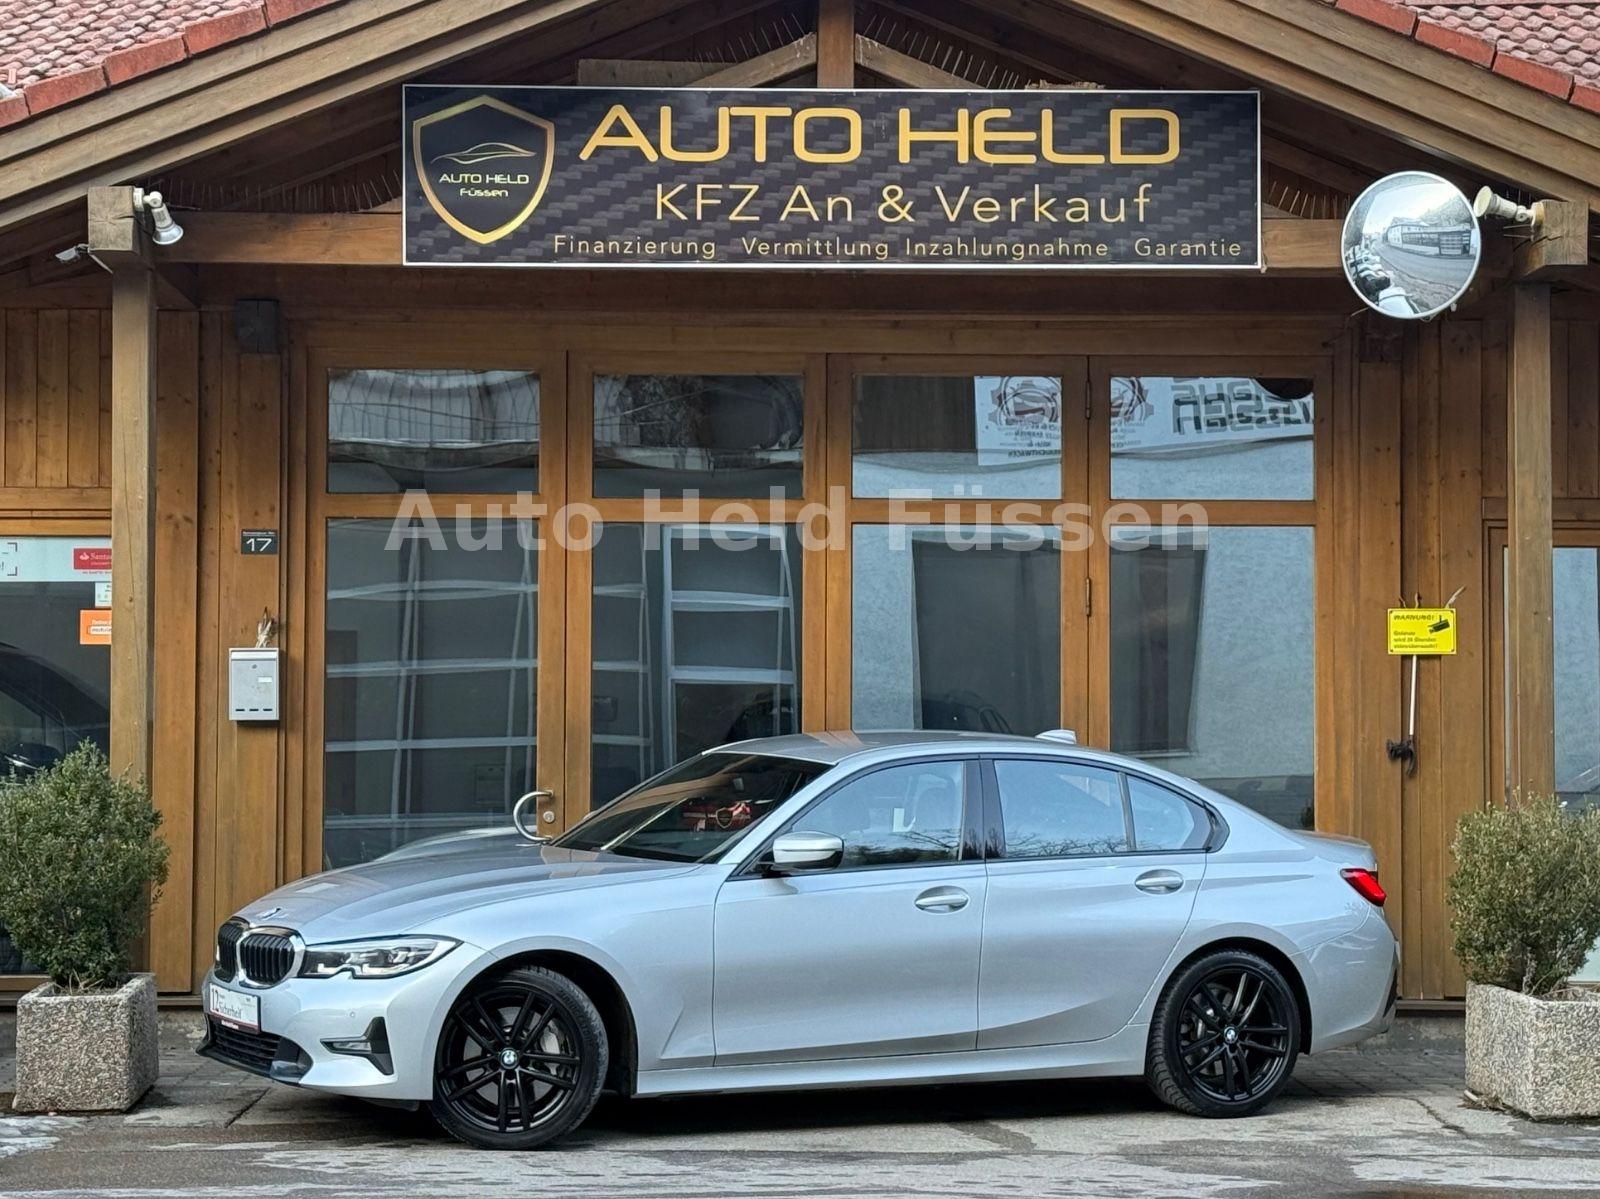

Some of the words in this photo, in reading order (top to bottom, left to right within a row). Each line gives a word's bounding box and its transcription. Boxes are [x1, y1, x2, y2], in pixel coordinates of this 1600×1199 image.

[579, 104, 863, 164] AUTO
[898, 107, 1181, 165] HELD
[439, 173, 482, 184] AUTO
[486, 174, 530, 184] HELD
[459, 187, 509, 197] Füssen
[656, 183, 760, 222] KFZ
[779, 184, 853, 222] An
[877, 183, 916, 223] &
[935, 183, 1153, 223] Verkauf
[553, 235, 717, 259] Finanzierung
[742, 236, 889, 259] Vermittlung
[905, 237, 1109, 259] Inzahlungnahme
[1134, 238, 1242, 257] Garantie
[246, 537, 272, 552] 17
